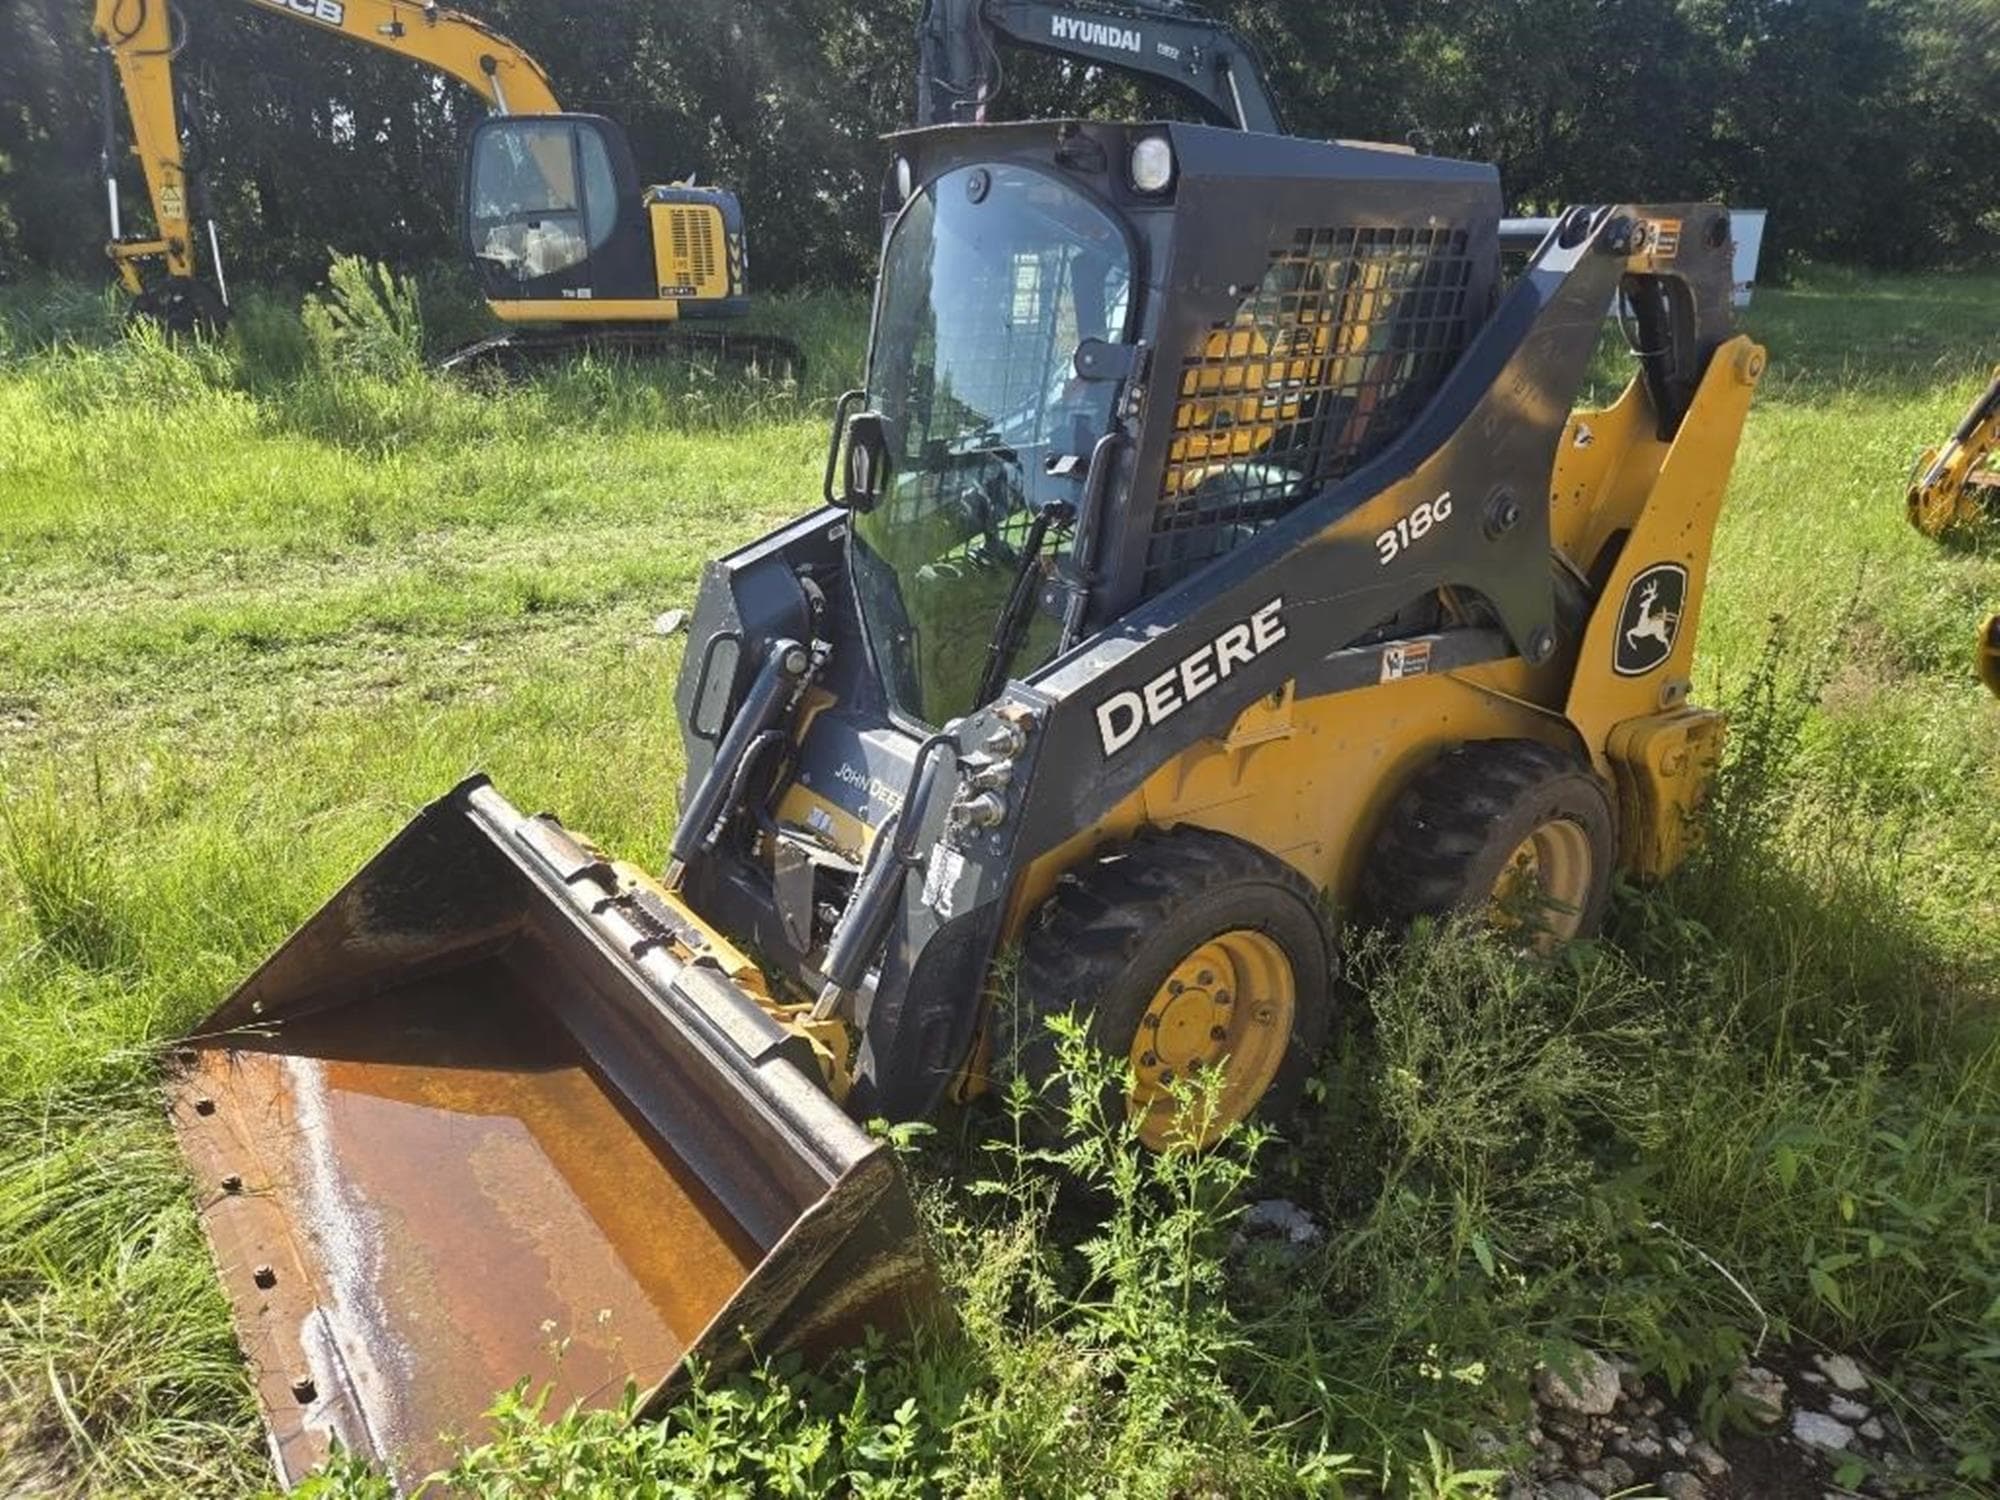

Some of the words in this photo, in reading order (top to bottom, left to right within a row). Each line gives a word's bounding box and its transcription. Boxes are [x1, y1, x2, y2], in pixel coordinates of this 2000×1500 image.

[268, 0, 344, 24] CB
[1052, 15, 1141, 53] HYUNDAI
[1376, 491, 1452, 565] 318G
[1096, 597, 1287, 757] DEERE
[834, 762, 870, 791] JOHN
[868, 778, 905, 809] DEE
